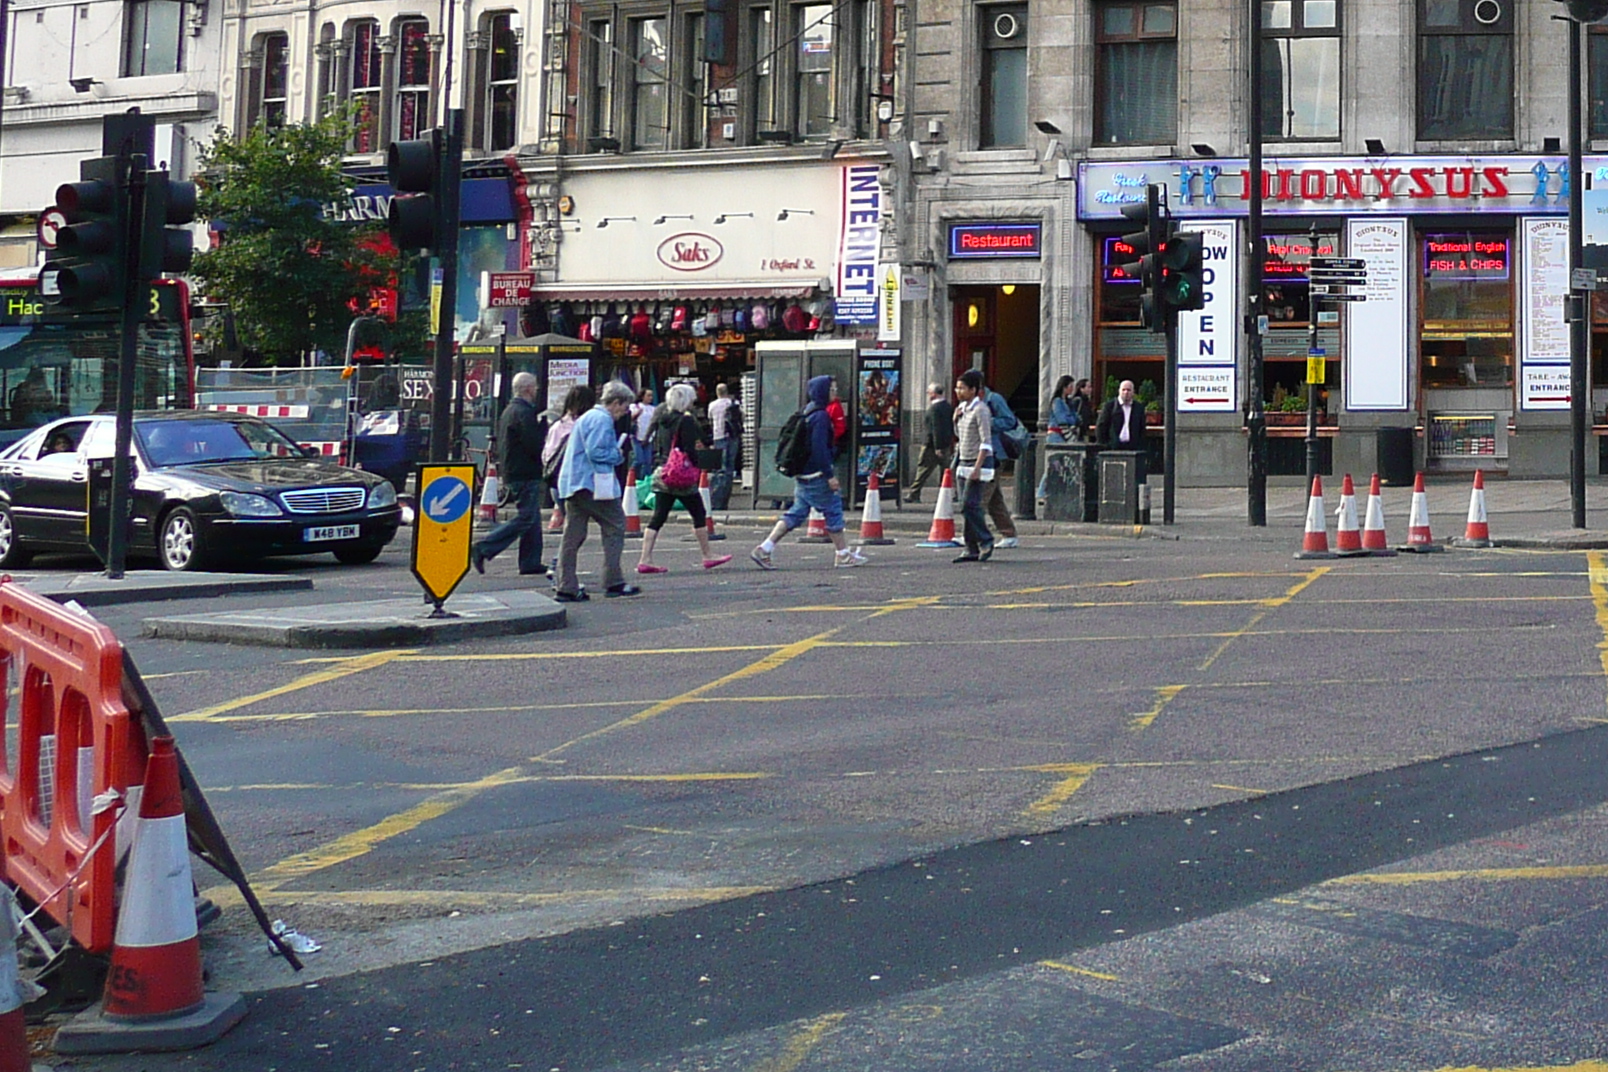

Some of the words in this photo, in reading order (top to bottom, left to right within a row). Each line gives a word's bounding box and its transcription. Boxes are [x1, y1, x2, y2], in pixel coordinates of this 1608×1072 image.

[1240, 167, 1509, 201] DIONYSUS
[844, 166, 880, 296] INTERNET
[1531, 221, 1570, 234] DIONYSU
[961, 233, 1034, 248] Restaurant
[671, 241, 710, 263] Saks
[1202, 245, 1228, 260] OW
[1428, 242, 1472, 252] Traditional
[1474, 241, 1506, 254] English
[769, 258, 801, 273] Oxford
[1430, 260, 1455, 270] FISH
[1459, 259, 1468, 271] &
[1470, 258, 1504, 271] CHIPS
[493, 280, 531, 289] BUREAU
[505, 289, 518, 297] DE
[491, 297, 531, 306] CHANGE
[1182, 374, 1230, 382] RESTAURANT
[1528, 373, 1550, 381] TAKE
[1184, 385, 1228, 393] ENTRANCE
[1530, 384, 1570, 392] ENTRANC
